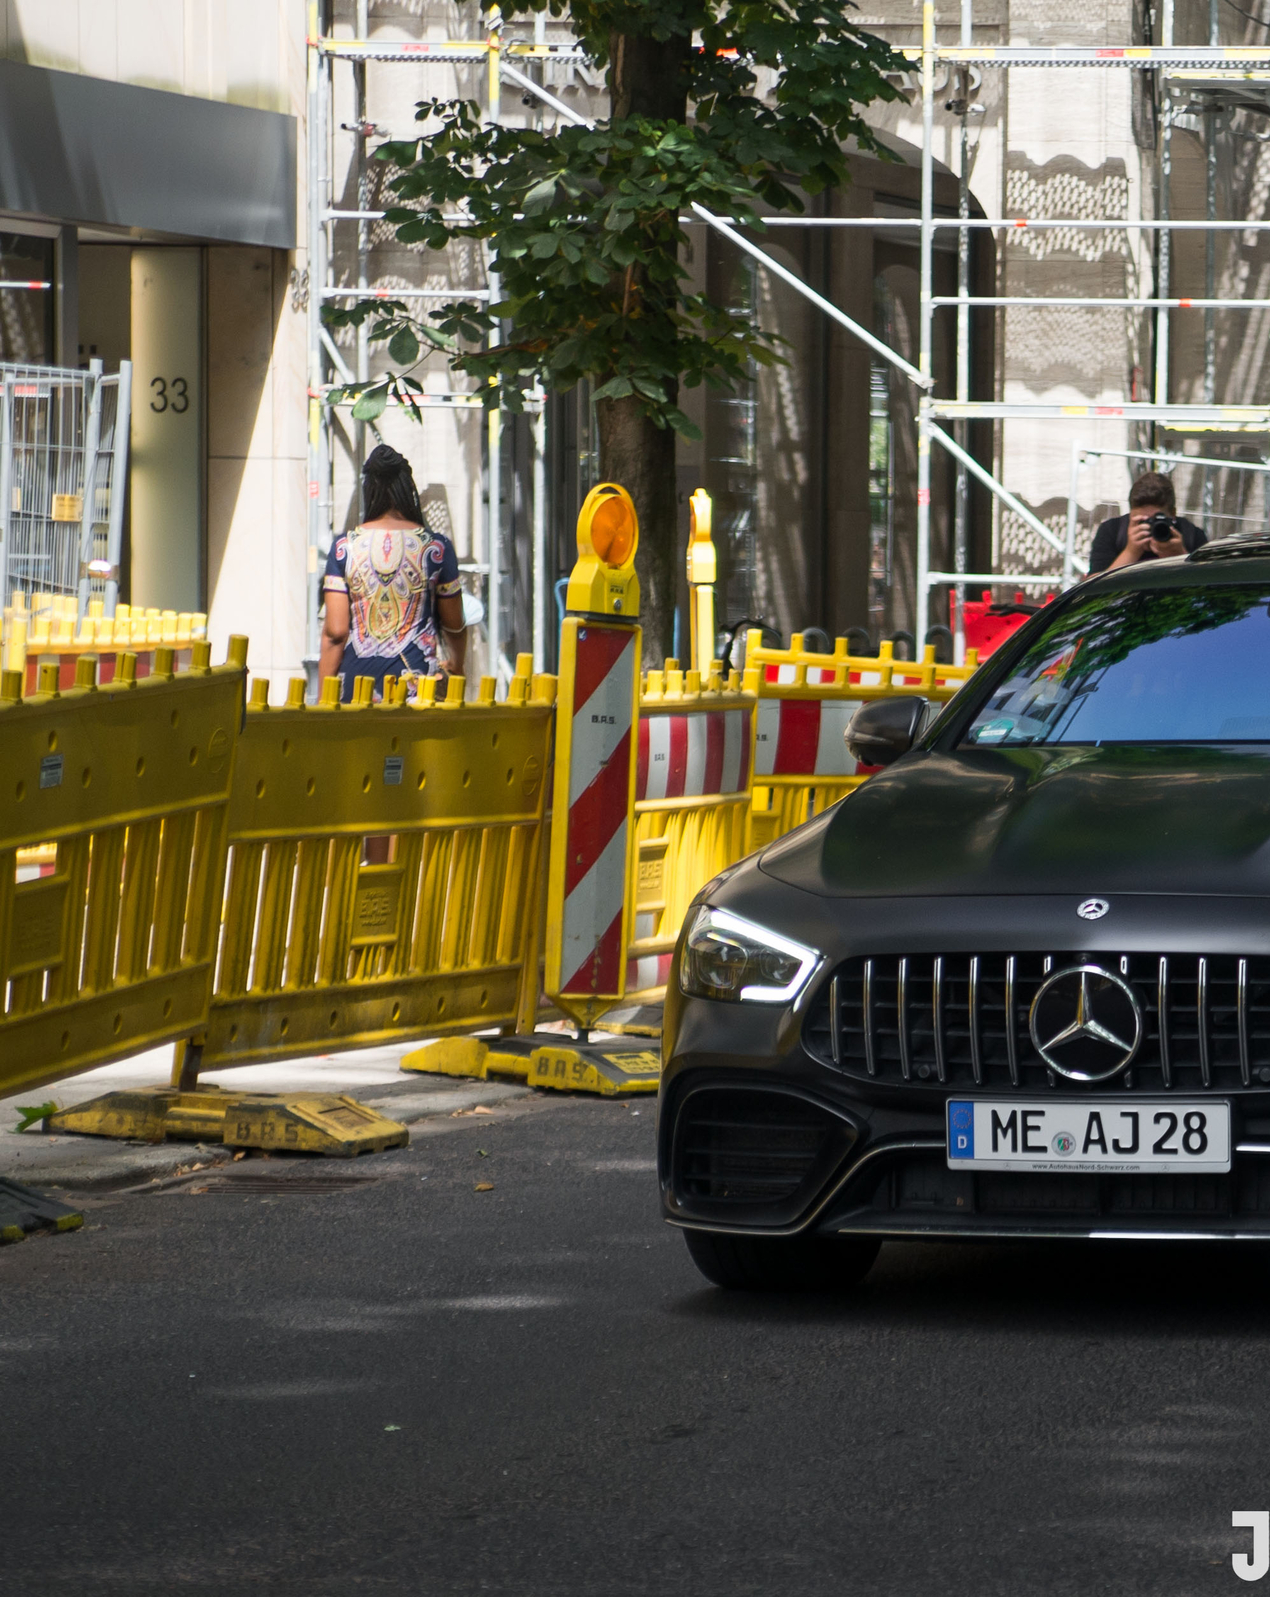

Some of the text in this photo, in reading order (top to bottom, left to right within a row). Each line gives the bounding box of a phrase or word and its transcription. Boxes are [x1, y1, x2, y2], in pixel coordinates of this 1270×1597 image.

[150, 376, 189, 414] 33
[957, 1135, 969, 1149] D
[991, 1109, 1208, 1155] ME AJ 28
[1032, 1163, 1140, 1172] www.AutohausNord-Schwarz.com
